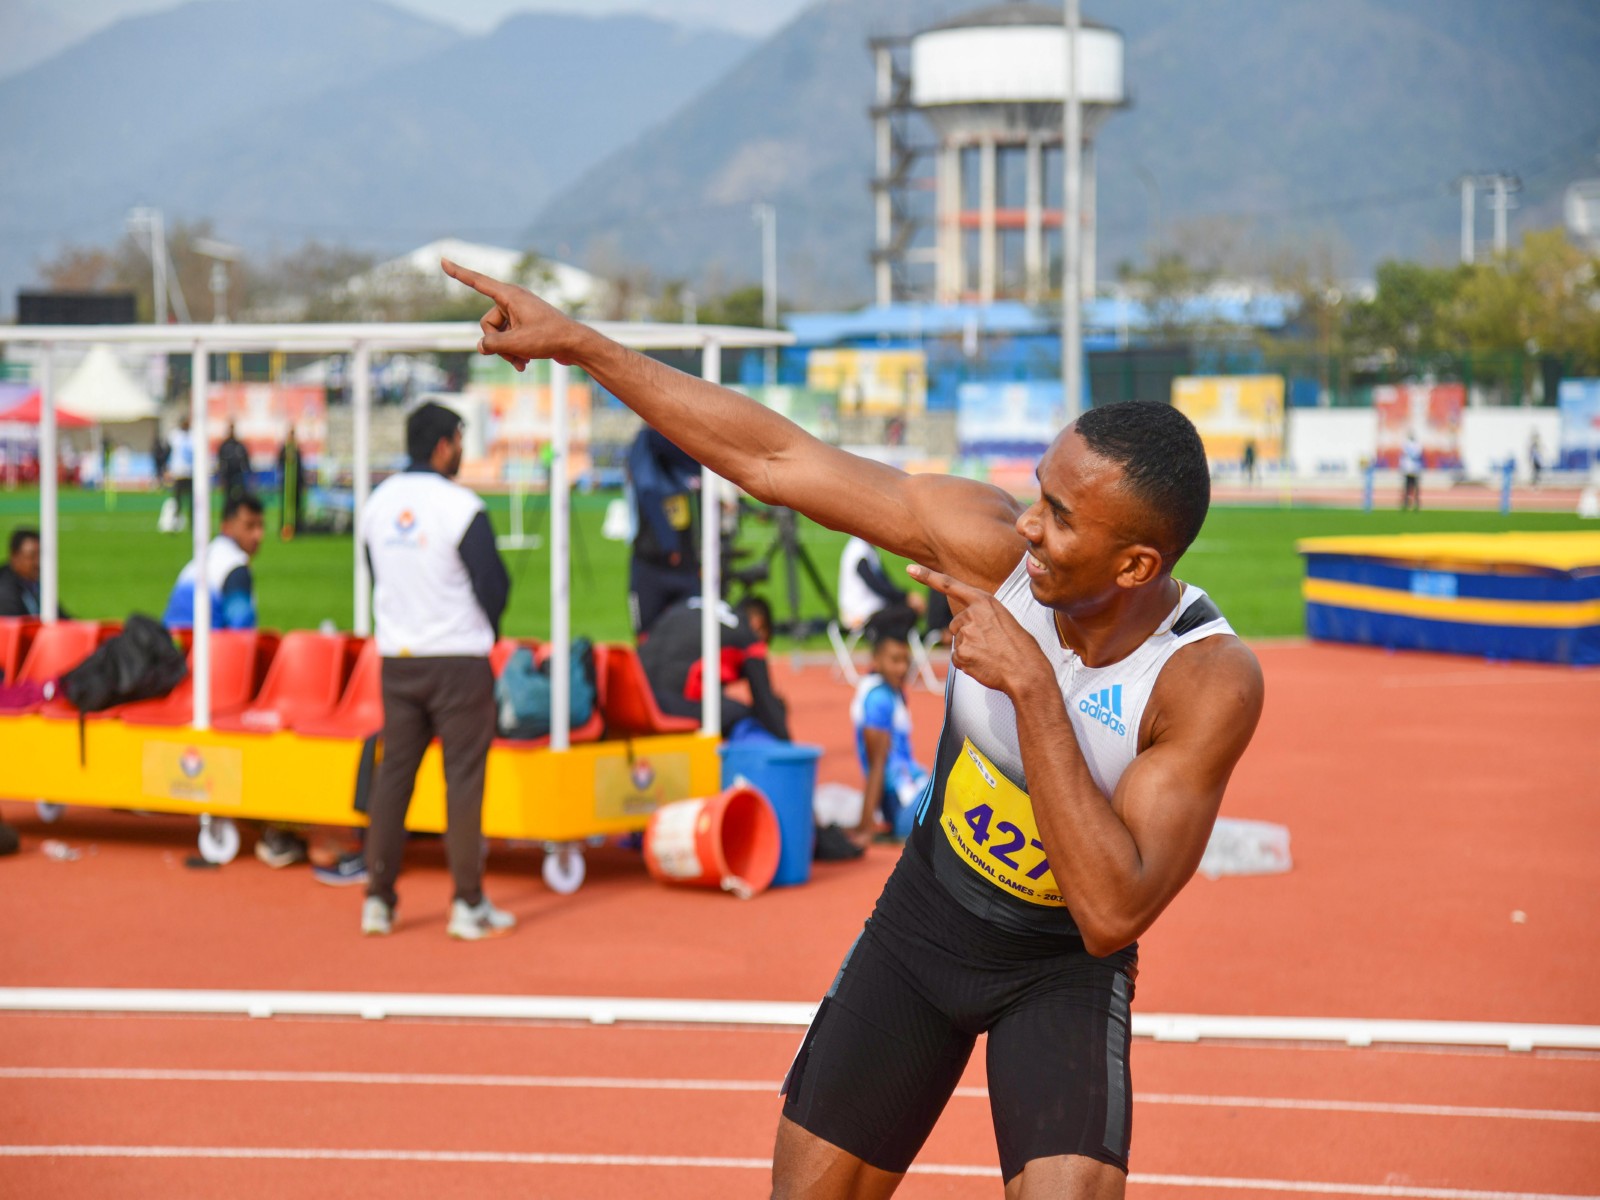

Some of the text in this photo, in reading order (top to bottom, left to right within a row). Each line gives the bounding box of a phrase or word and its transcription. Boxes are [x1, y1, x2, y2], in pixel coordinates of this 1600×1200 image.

[1079, 699, 1126, 737] adidas
[957, 834, 996, 878] NATIONAL
[998, 874, 1035, 897] GAMES
[964, 803, 1052, 881] 427
